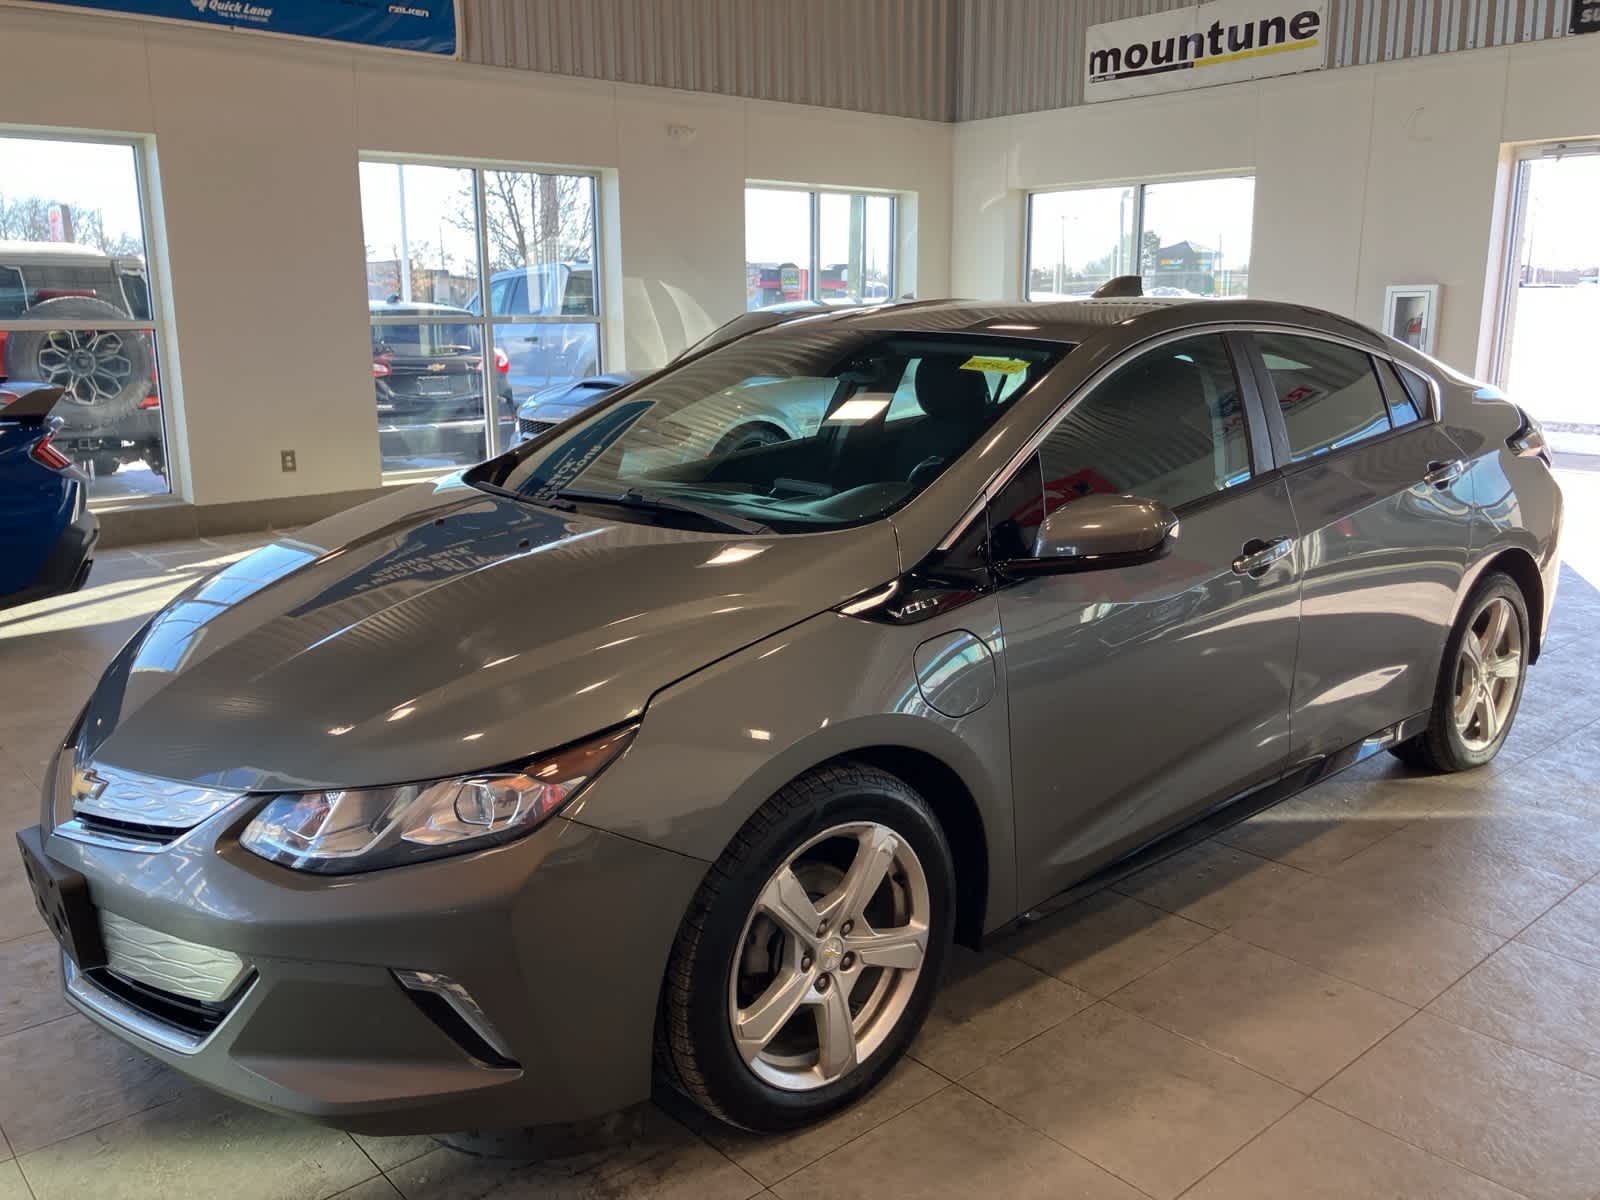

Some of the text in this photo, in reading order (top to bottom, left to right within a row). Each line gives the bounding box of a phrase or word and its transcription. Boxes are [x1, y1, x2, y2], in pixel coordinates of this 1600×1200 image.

[208, 0, 242, 12] Quick
[243, 3, 272, 17] Lane
[1089, 10, 1320, 75] mountune
